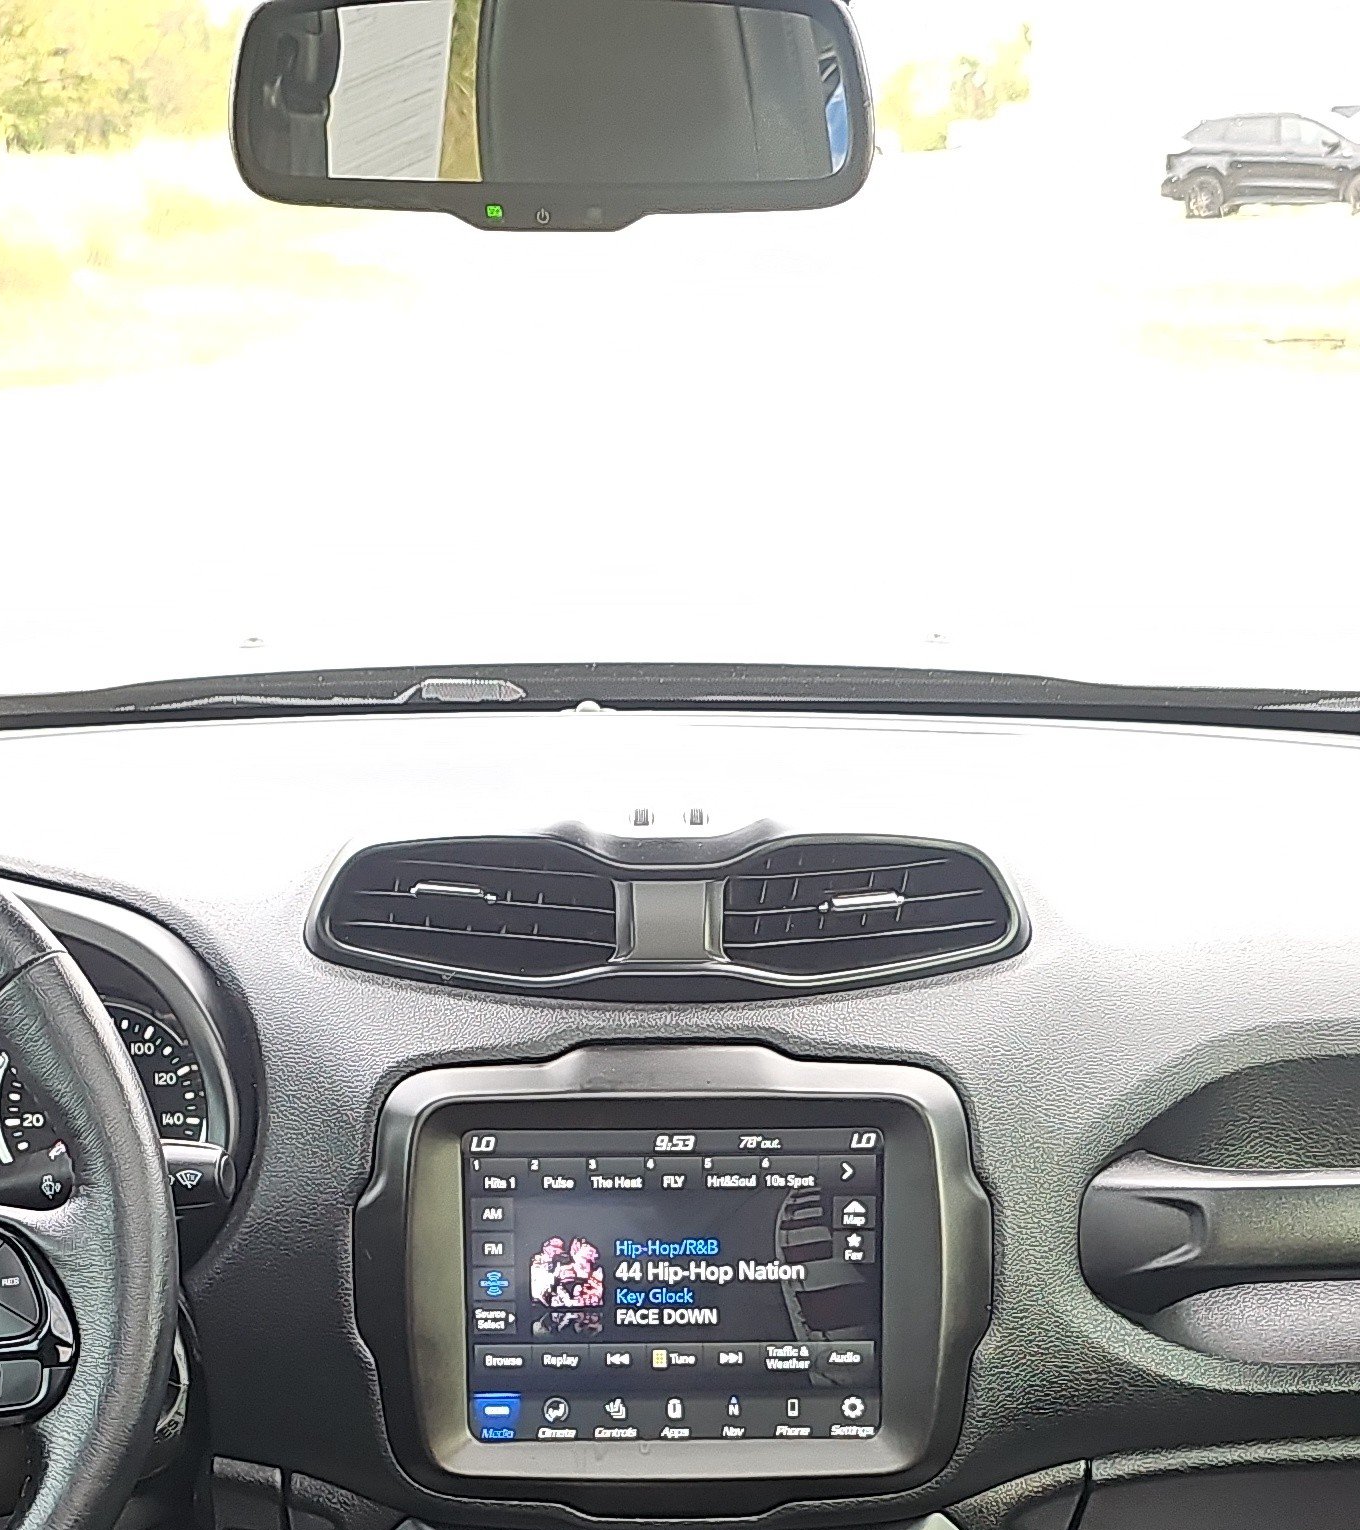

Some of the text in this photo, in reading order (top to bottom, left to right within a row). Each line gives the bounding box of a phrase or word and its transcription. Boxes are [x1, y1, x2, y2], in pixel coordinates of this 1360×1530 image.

[131, 1043, 154, 1055] 100
[154, 1073, 177, 1085] 120
[23, 1114, 44, 1127] 20
[162, 1113, 184, 1125] 140
[470, 1136, 496, 1151] LO
[654, 1134, 696, 1151] 9:53
[850, 1133, 877, 1149] LO
[530, 1159, 539, 1170] 2
[588, 1159, 597, 1170] 3
[646, 1159, 655, 1169] 4
[704, 1158, 712, 1168] 5
[761, 1157, 770, 1168] 6
[484, 1177, 507, 1189] Hits
[543, 1176, 575, 1189] Pulse
[590, 1176, 643, 1189] The Heat
[663, 1175, 685, 1188] FLY
[765, 1175, 814, 1188] 10s Spot
[482, 1208, 503, 1220] AM
[843, 1214, 866, 1226] Map
[484, 1243, 503, 1255] FM
[615, 1239, 719, 1258] Hip-Hop/R&B
[615, 1261, 805, 1285] 44 Hip-Hop Nation
[616, 1288, 694, 1307] Key Glock
[475, 1309, 506, 1319] Source
[616, 1308, 718, 1325] FACE DOWN
[477, 1320, 505, 1330] Select
[766, 1346, 798, 1357] Traffic
[829, 1352, 861, 1363] Audio
[485, 1355, 523, 1367] Browse
[543, 1354, 579, 1367] Replay
[670, 1353, 696, 1365] Tune
[766, 1358, 811, 1370] Weather
[594, 1427, 638, 1438] Controls
[661, 1427, 690, 1438] Apps
[722, 1425, 745, 1436] Nav
[775, 1425, 811, 1436] Phone
[830, 1425, 875, 1437] Settings
